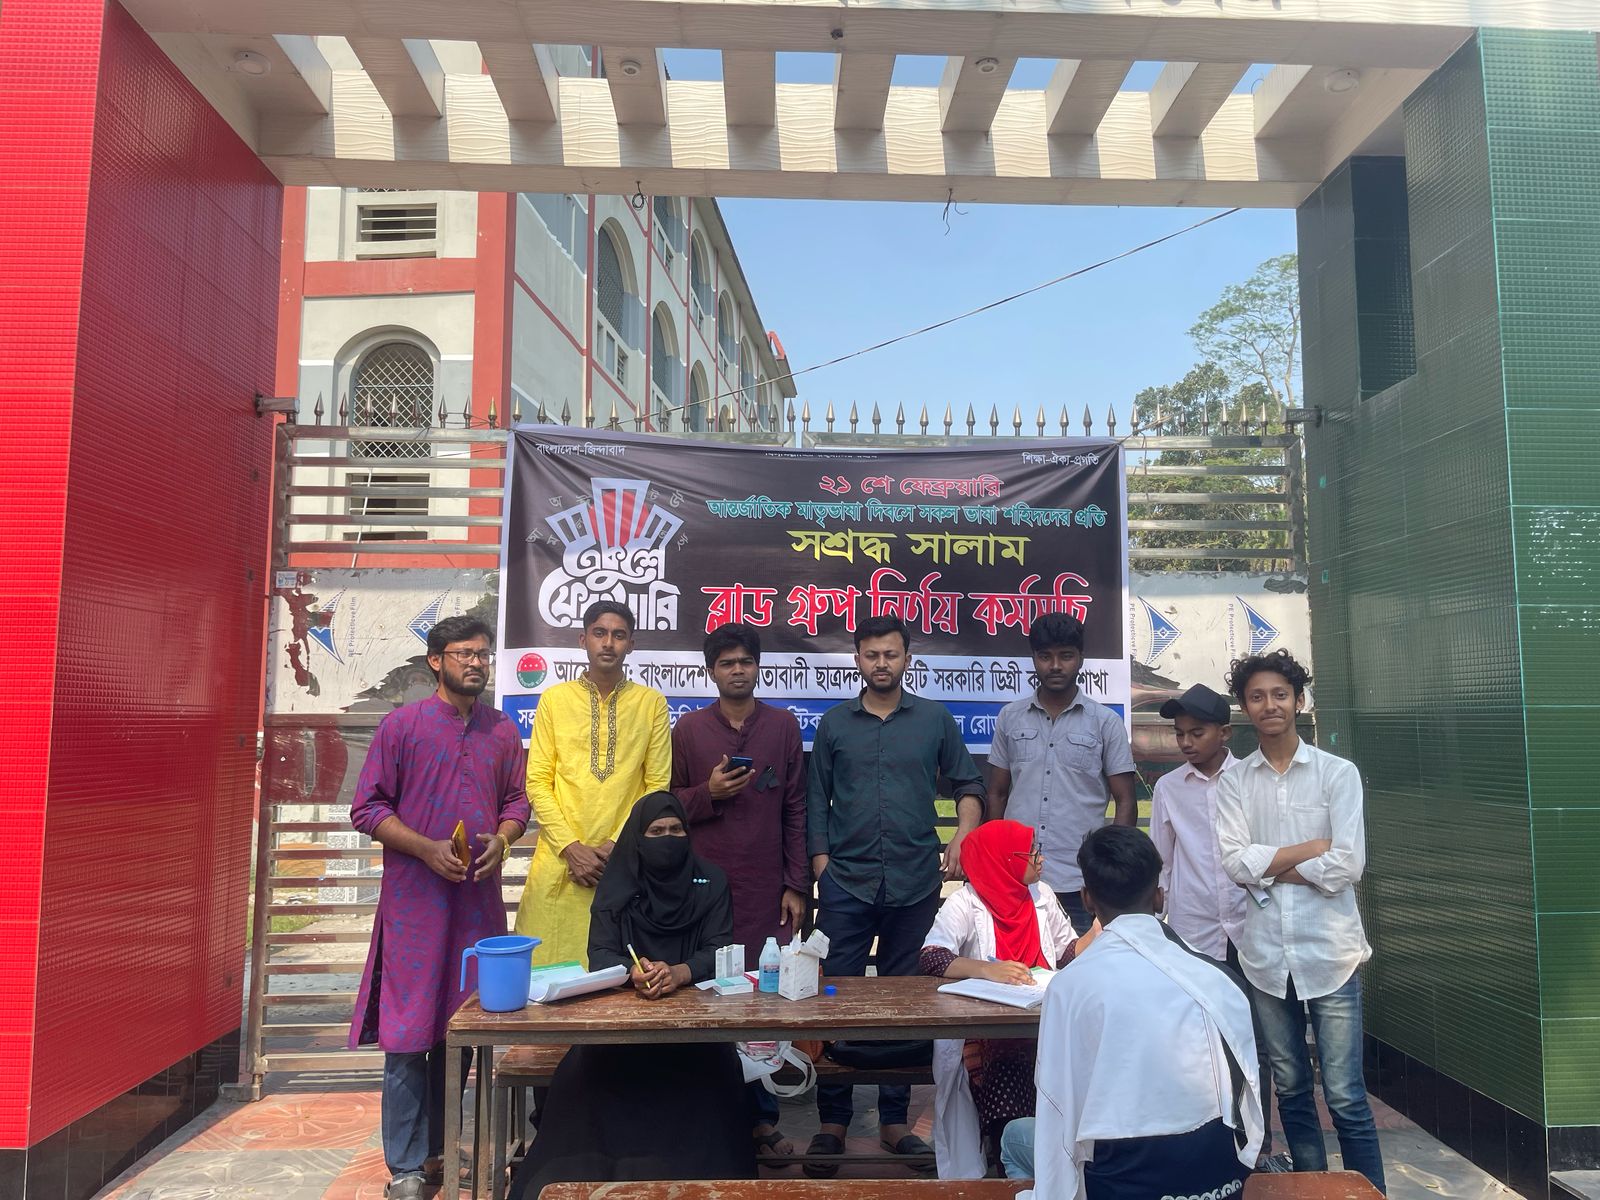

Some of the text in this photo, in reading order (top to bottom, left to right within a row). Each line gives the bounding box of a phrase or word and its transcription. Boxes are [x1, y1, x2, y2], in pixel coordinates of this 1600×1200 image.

[818, 473, 1004, 498] ২১ শে ফেব্রুয়ারি
[706, 494, 793, 519] আন্তর্জাতিক
[795, 500, 863, 528] মাতৃভাষা
[865, 498, 916, 523] দিবসে
[918, 504, 961, 524] সকল
[961, 505, 1000, 525] ভাষা
[1074, 503, 1108, 529] প্রতি
[786, 527, 1032, 566] সশ্রদ্ধ সালাম
[787, 584, 862, 636] গ্রুপ
[866, 567, 964, 635] নির্ণয়
[638, 661, 707, 690] বাংলাদেশ
[932, 660, 986, 693] সরকারি
[989, 661, 1023, 695] ডিগ্রী
